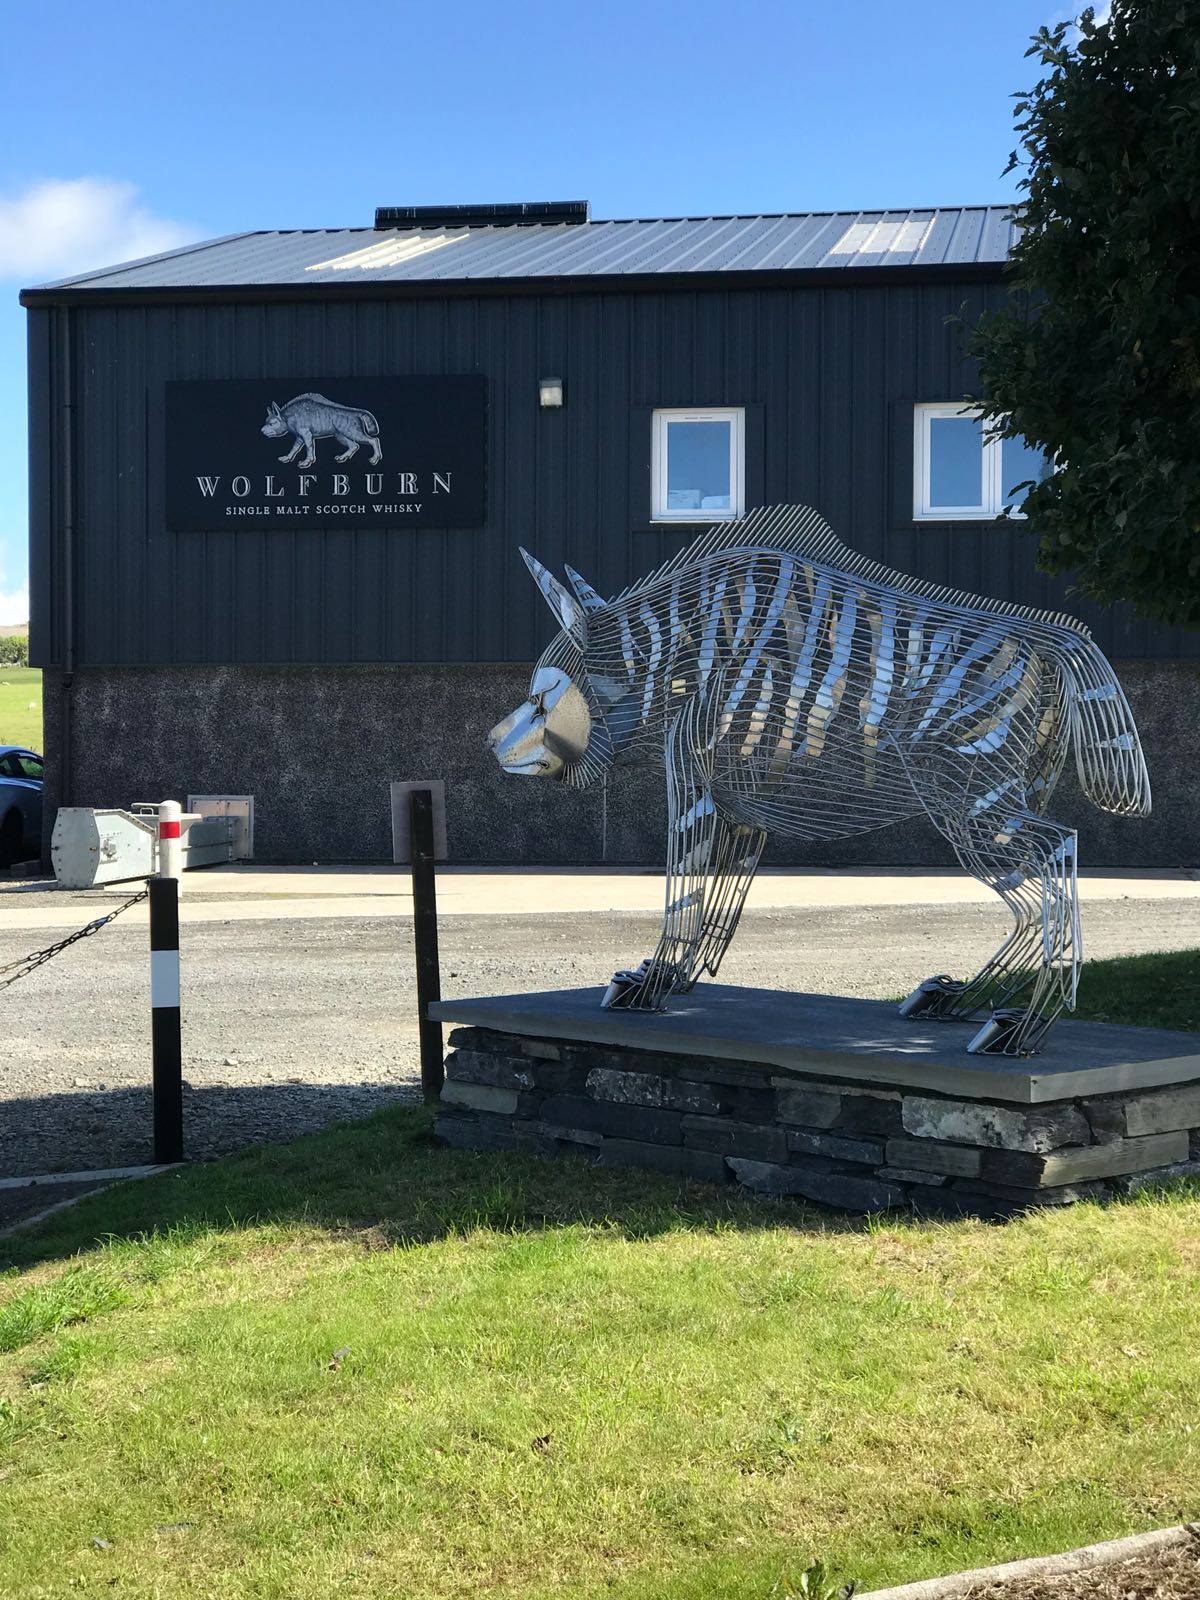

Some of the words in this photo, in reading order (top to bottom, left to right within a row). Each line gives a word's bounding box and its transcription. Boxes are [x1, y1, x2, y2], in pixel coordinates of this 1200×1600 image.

[195, 472, 453, 497] WOLFBURN
[225, 506, 271, 516] SINGLE
[276, 505, 310, 515] MALT
[315, 504, 366, 514] SCOTCH
[372, 503, 423, 514] WHISKY
